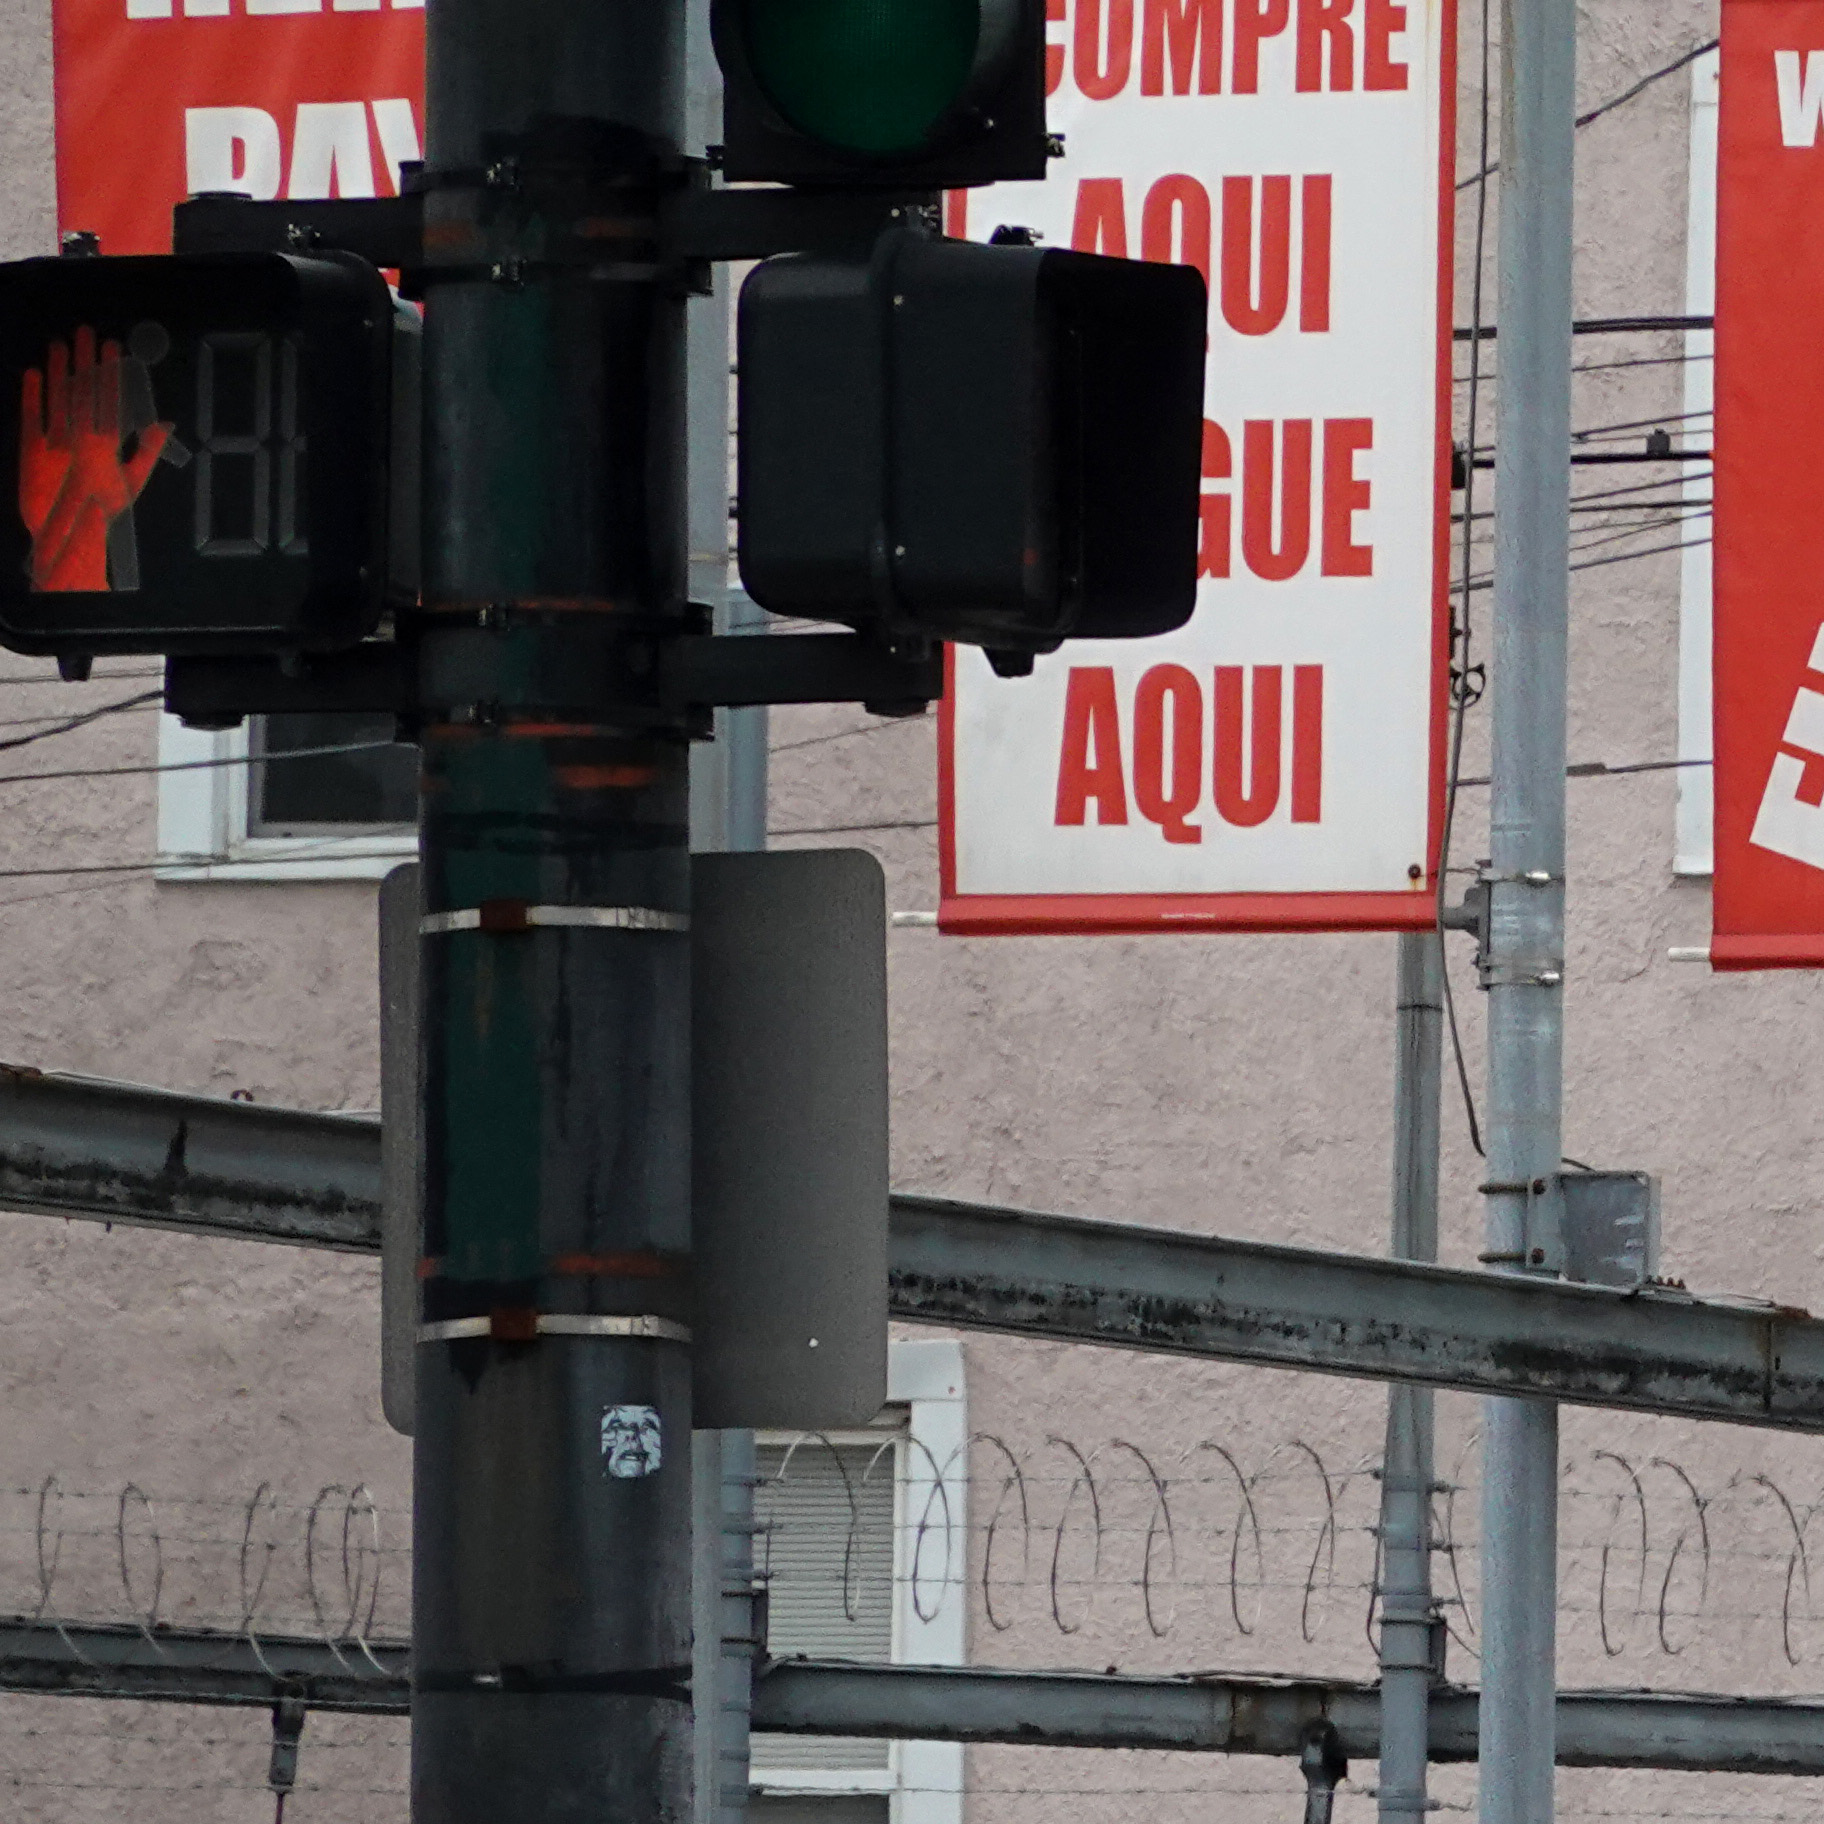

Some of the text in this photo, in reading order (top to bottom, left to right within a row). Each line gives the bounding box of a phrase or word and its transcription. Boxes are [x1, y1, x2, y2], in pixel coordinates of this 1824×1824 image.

[1046, 0, 1408, 100] OMPRE
[185, 98, 421, 200] PA
[1197, 418, 1374, 582] GUE
[1054, 664, 1324, 844] AQUI
